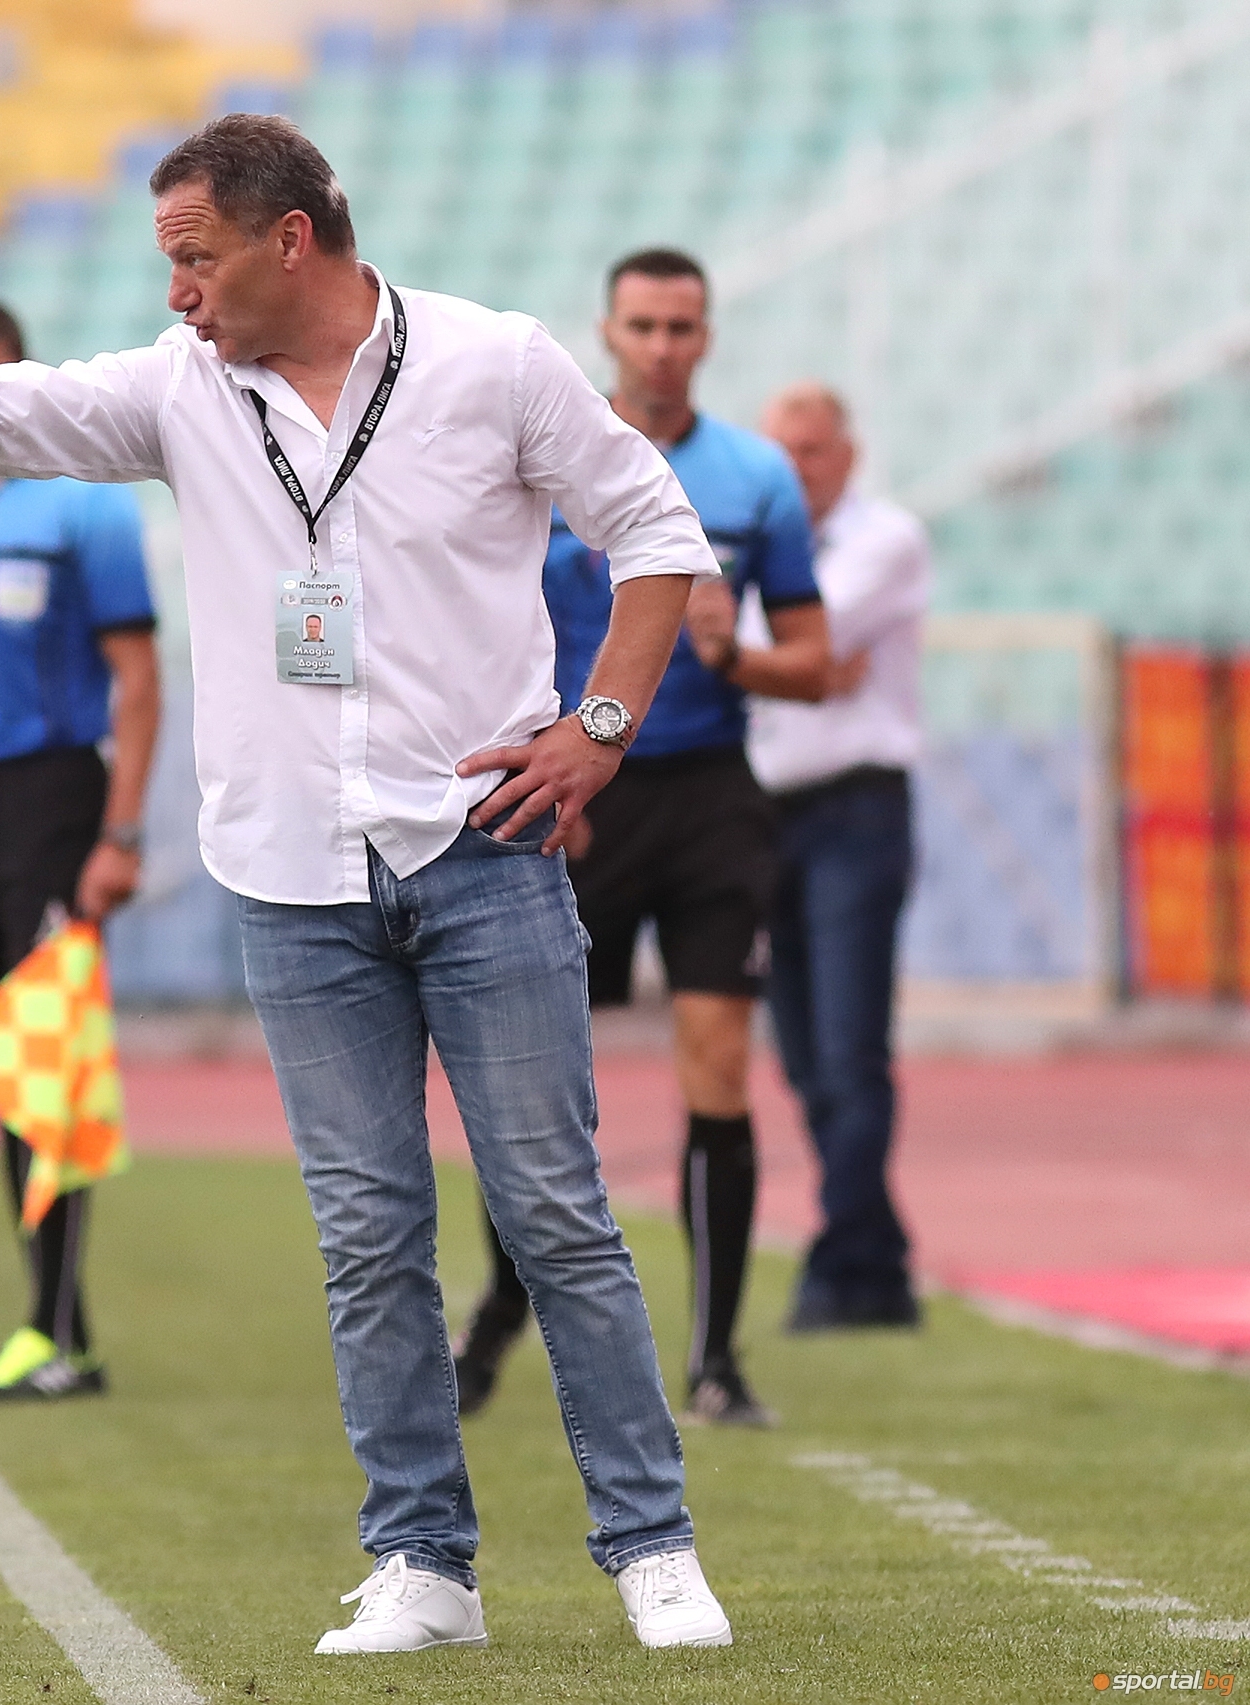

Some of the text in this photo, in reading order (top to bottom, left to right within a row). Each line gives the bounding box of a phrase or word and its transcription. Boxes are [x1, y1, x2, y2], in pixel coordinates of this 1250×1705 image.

[364, 382, 392, 431] ВТОРА ЛИГА
[342, 455, 358, 476] ЛИГА
[273, 454, 304, 502] ВТОРА ЛИГА
[299, 581, 340, 590] Паспорт
[293, 645, 334, 658] Младен
